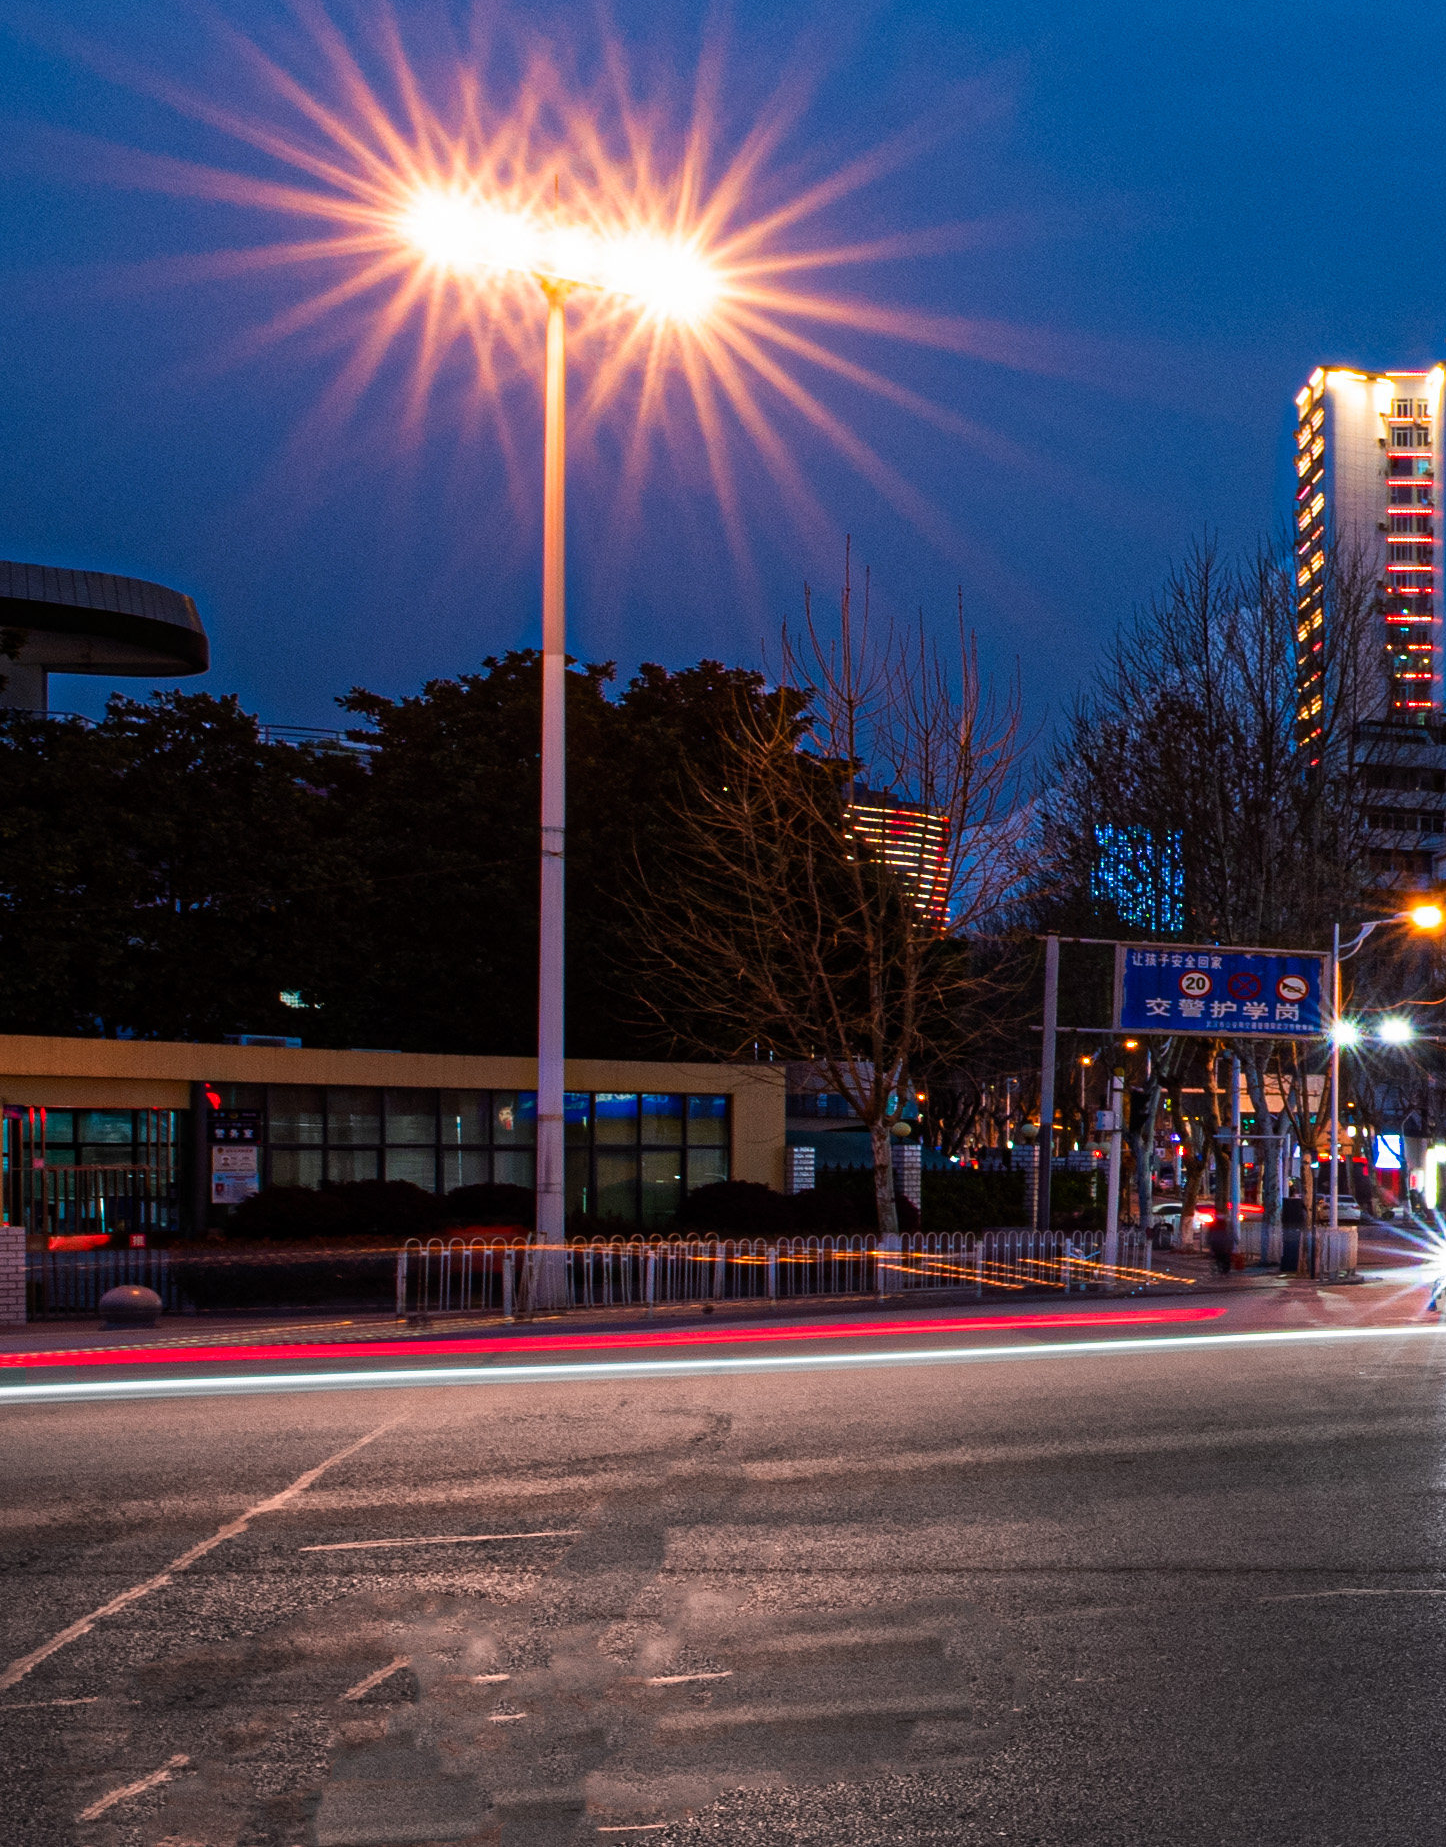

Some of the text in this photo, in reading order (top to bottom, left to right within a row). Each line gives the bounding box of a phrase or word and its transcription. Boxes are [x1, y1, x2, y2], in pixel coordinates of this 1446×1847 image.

[1131, 952, 1223, 970] 让孩子安全回家
[1185, 977, 1206, 991] 20
[1145, 997, 1300, 1022] 交警护学岗
